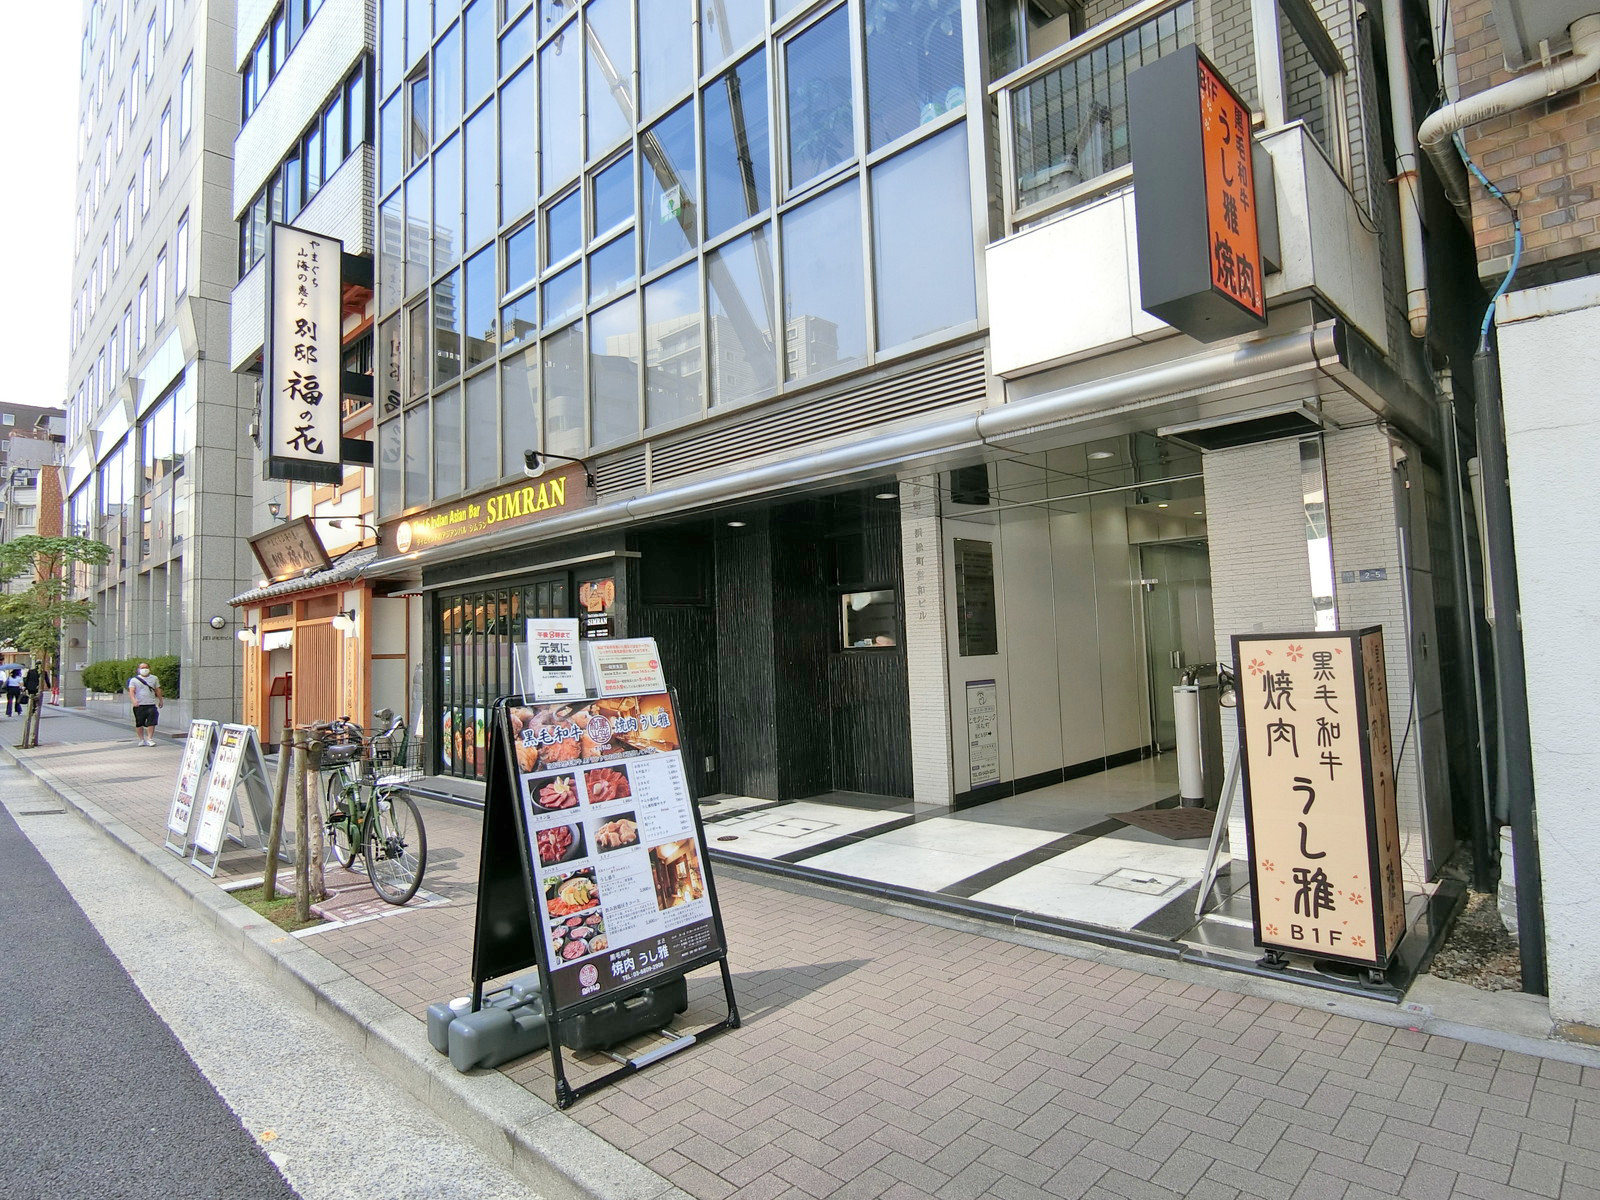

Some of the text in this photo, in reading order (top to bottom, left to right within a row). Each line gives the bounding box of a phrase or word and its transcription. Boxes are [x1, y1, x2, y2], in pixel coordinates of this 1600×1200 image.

[1200, 70, 1218, 103] B1F
[1218, 106, 1240, 236] うし雅
[1233, 104, 1249, 213] 黒毛和牛
[296, 248, 310, 308] 山海の恵み
[310, 240, 321, 288] やまぐち
[1214, 231, 1256, 308] 焼肉
[283, 318, 324, 455] 別邸福の花
[431, 511, 449, 529] Indian
[449, 508, 467, 525] Asian
[468, 503, 481, 520] Bar
[487, 476, 567, 525] SIMRAN
[1365, 570, 1381, 579] 2-5
[537, 630, 571, 639] 午後8時まで
[587, 617, 608, 627] SIMRAN
[537, 654, 573, 666] 営業中!
[539, 642, 570, 654] 元気に
[523, 724, 584, 748] 黒毛和牛
[614, 717, 638, 734] 焼肉
[640, 711, 671, 729] うし雅
[1262, 670, 1300, 759] 焼肉
[1312, 650, 1343, 781] 黒毛和牛
[1291, 775, 1337, 921] うし雅
[1290, 923, 1343, 947] B1F
[609, 948, 632, 962] 黒毛和牛
[611, 945, 670, 977] 焼肉 うし雅
